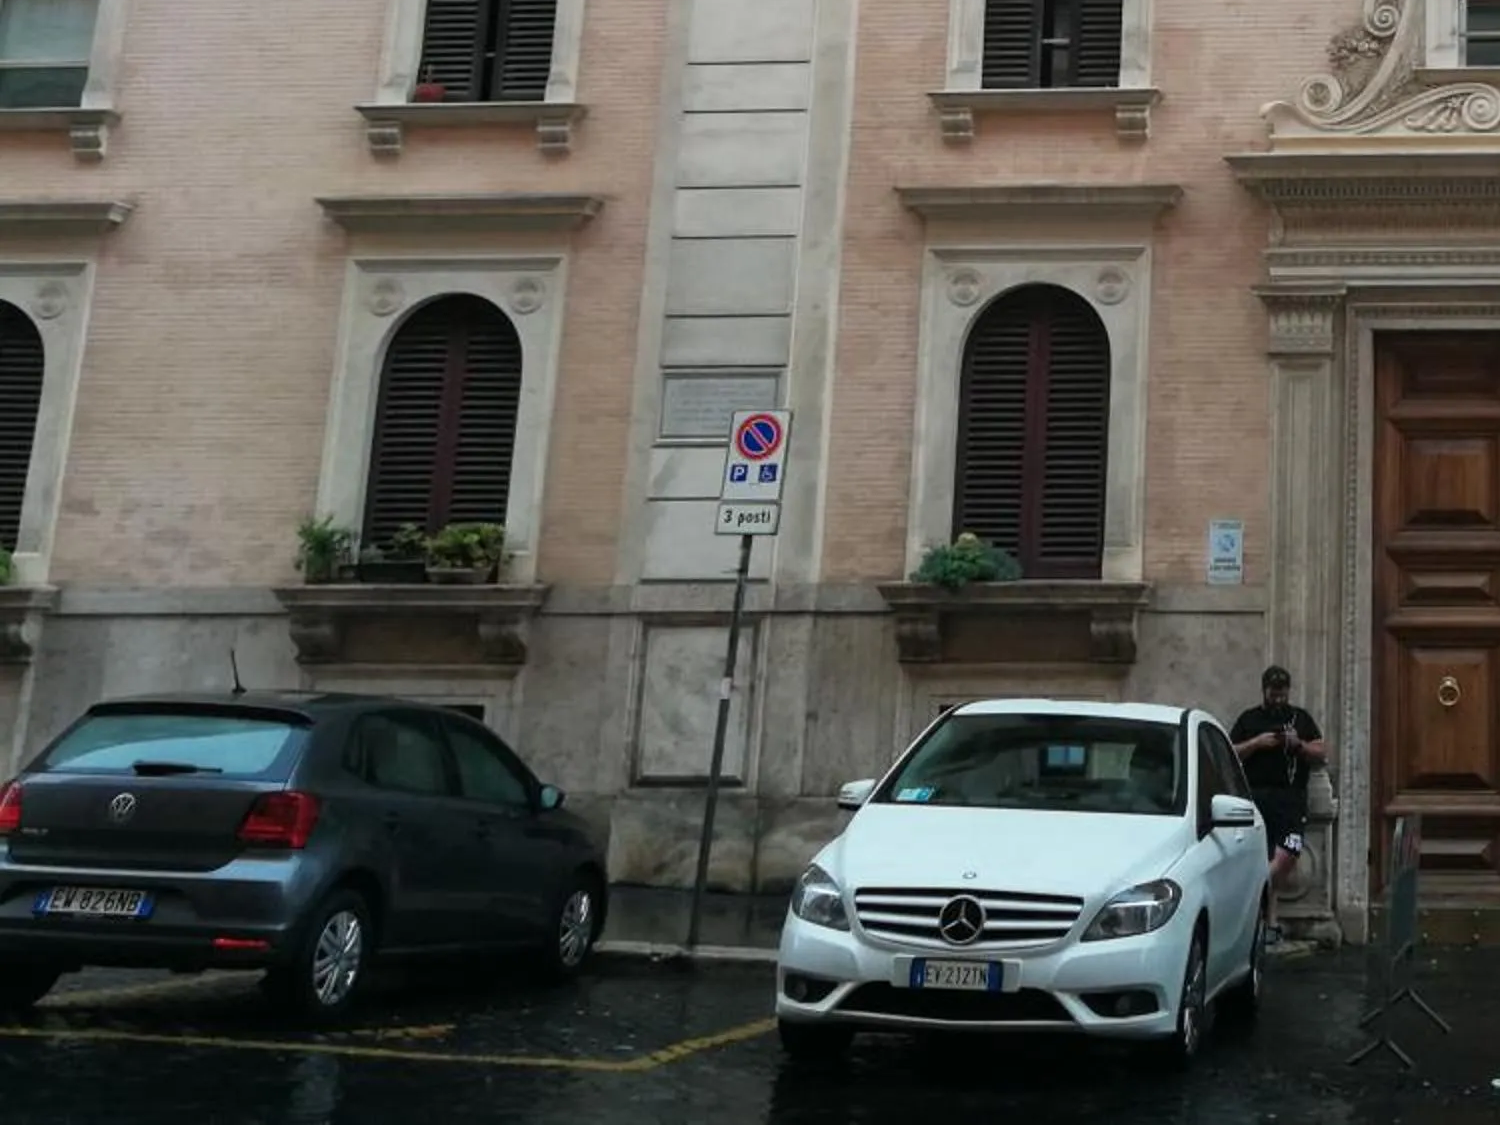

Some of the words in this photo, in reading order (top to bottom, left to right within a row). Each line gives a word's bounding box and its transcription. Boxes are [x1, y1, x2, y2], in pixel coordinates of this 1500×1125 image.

[733, 466, 745, 480] P
[723, 510, 733, 524] 3
[737, 509, 771, 527] posti
